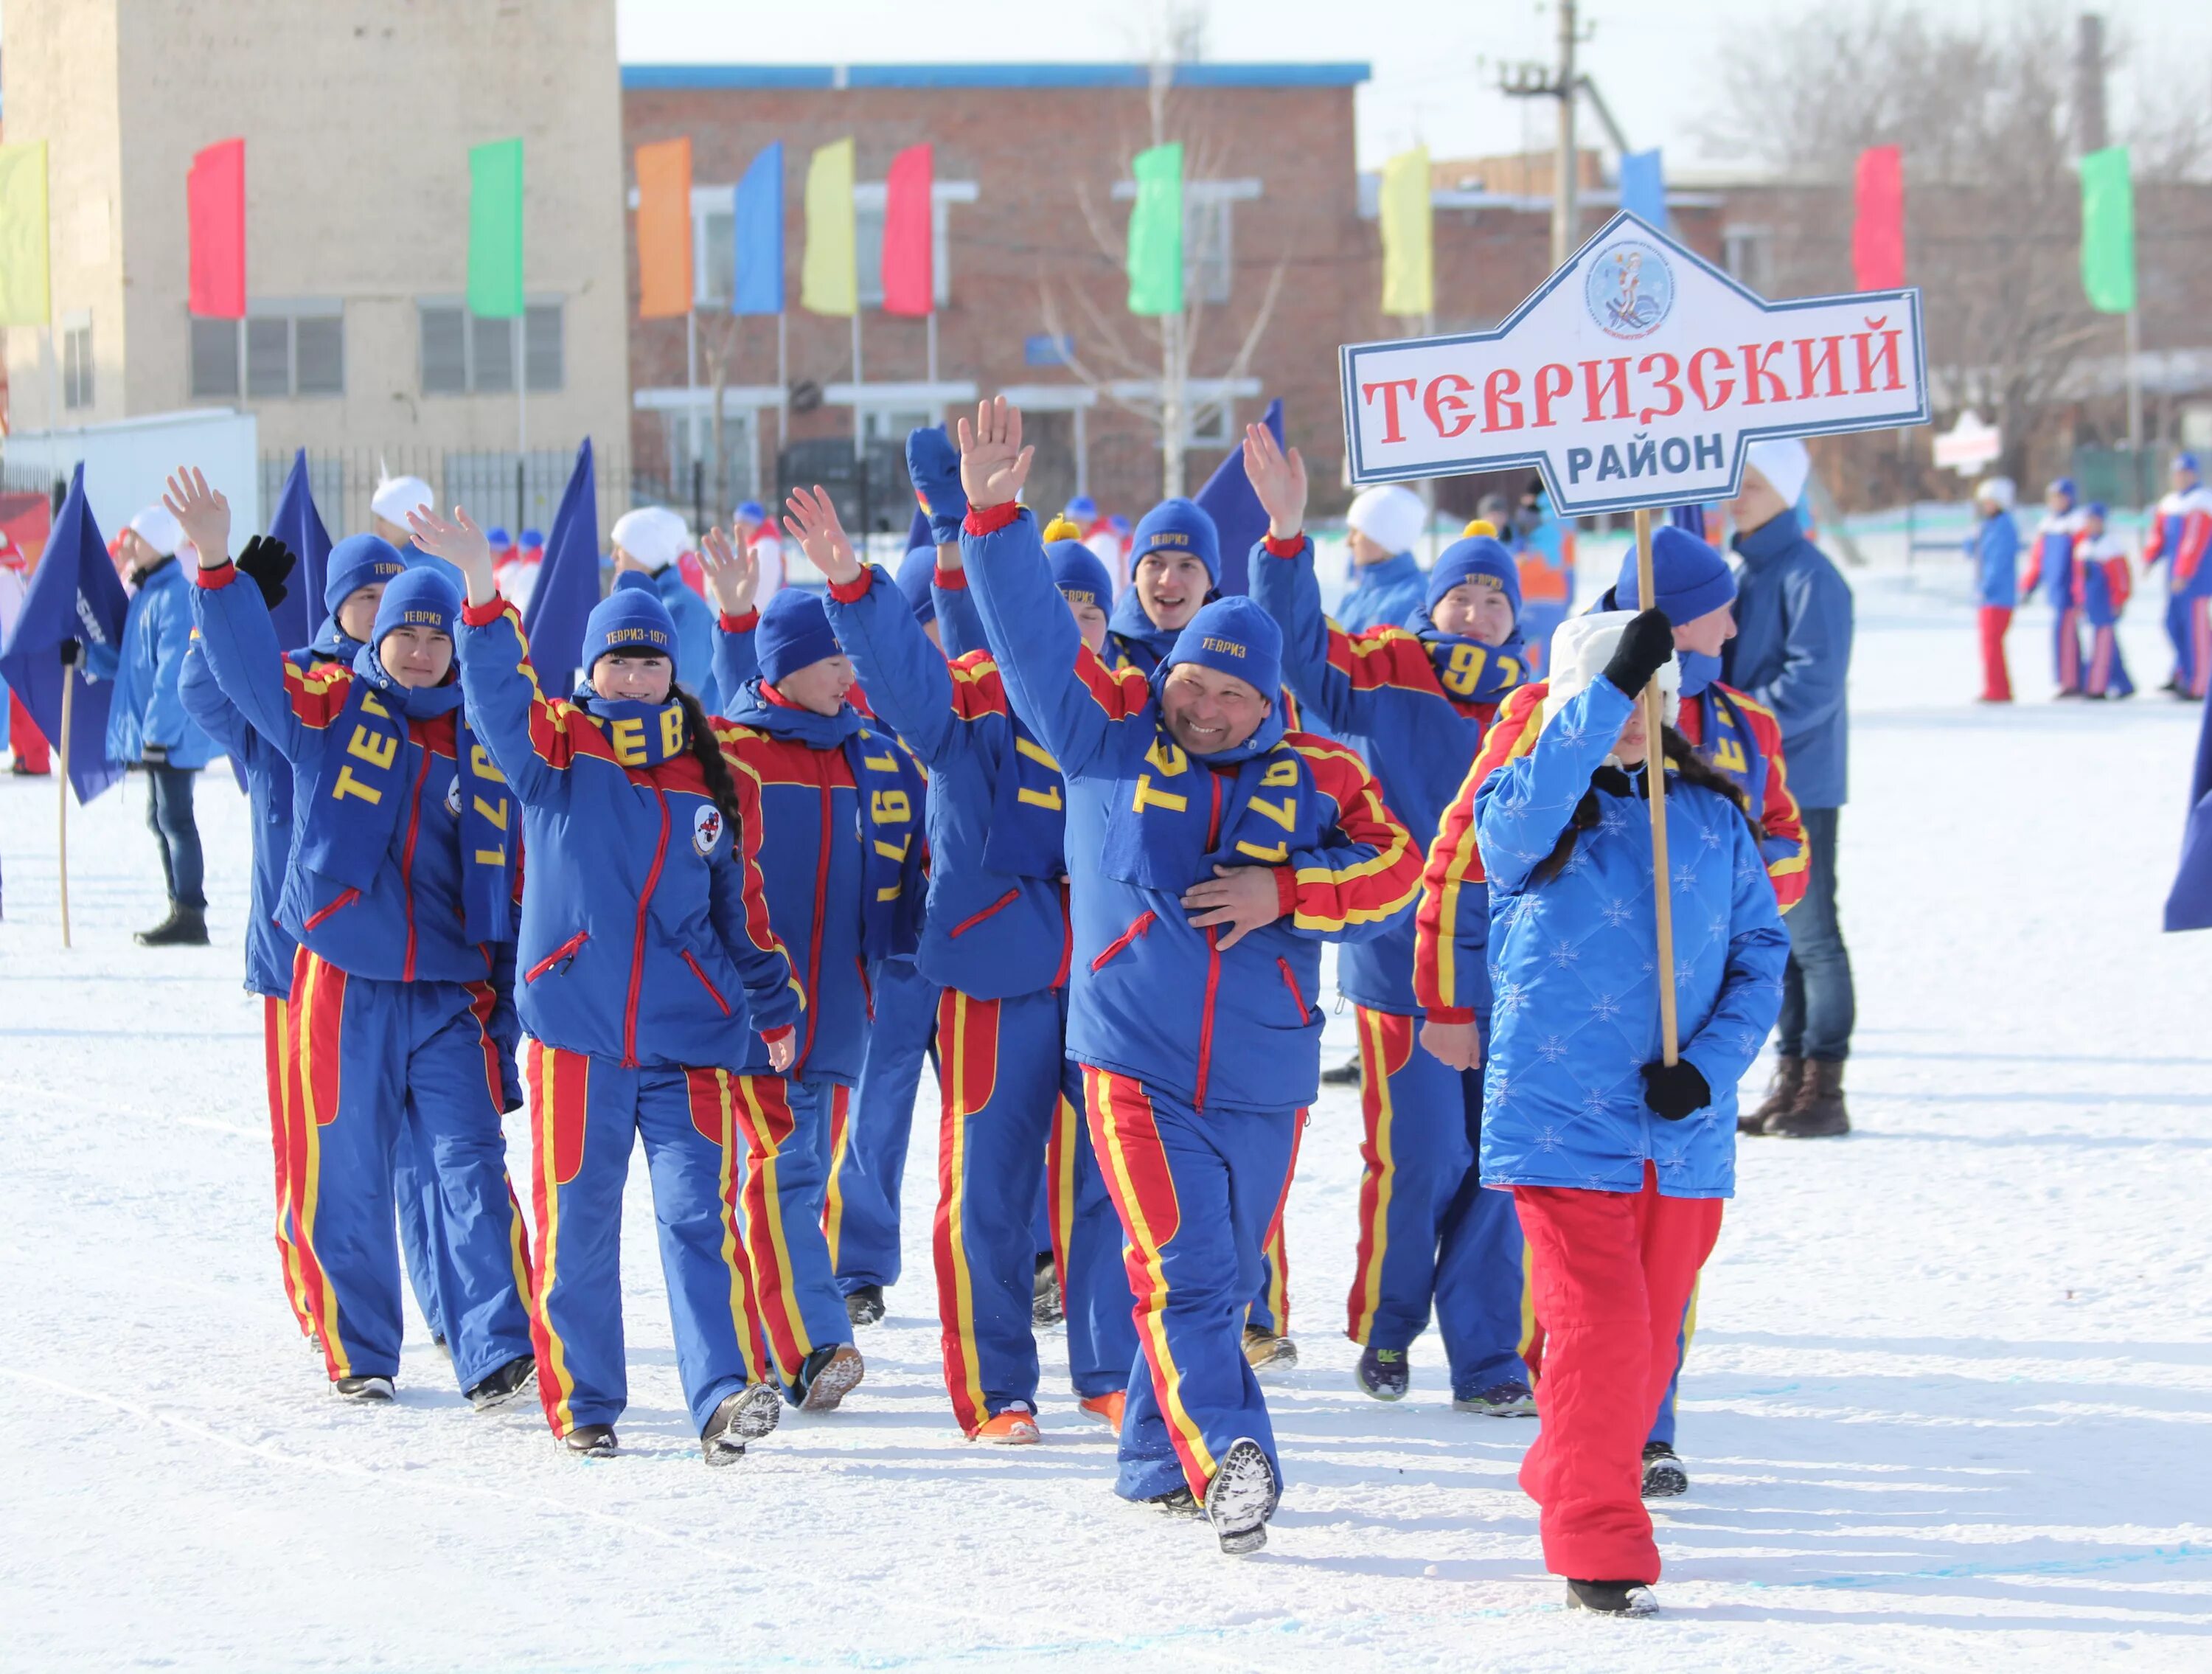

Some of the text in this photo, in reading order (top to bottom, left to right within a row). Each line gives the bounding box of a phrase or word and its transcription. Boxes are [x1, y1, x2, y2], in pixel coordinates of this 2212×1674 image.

[1363, 316, 1907, 444] ТЕВРИЗСКИЙ
[1566, 432, 1724, 485] РАЙОН
[404, 610, 442, 626] ТЕВРИЗ
[1062, 589, 1096, 604] ЕВРИЗ
[605, 628, 668, 647] ТЕВРИЗ-1971
[1201, 636, 1247, 659] ТЕВРИЗ
[1422, 641, 1520, 695] 97
[586, 705, 684, 766] ЕВ
[1235, 740, 1298, 863] 971
